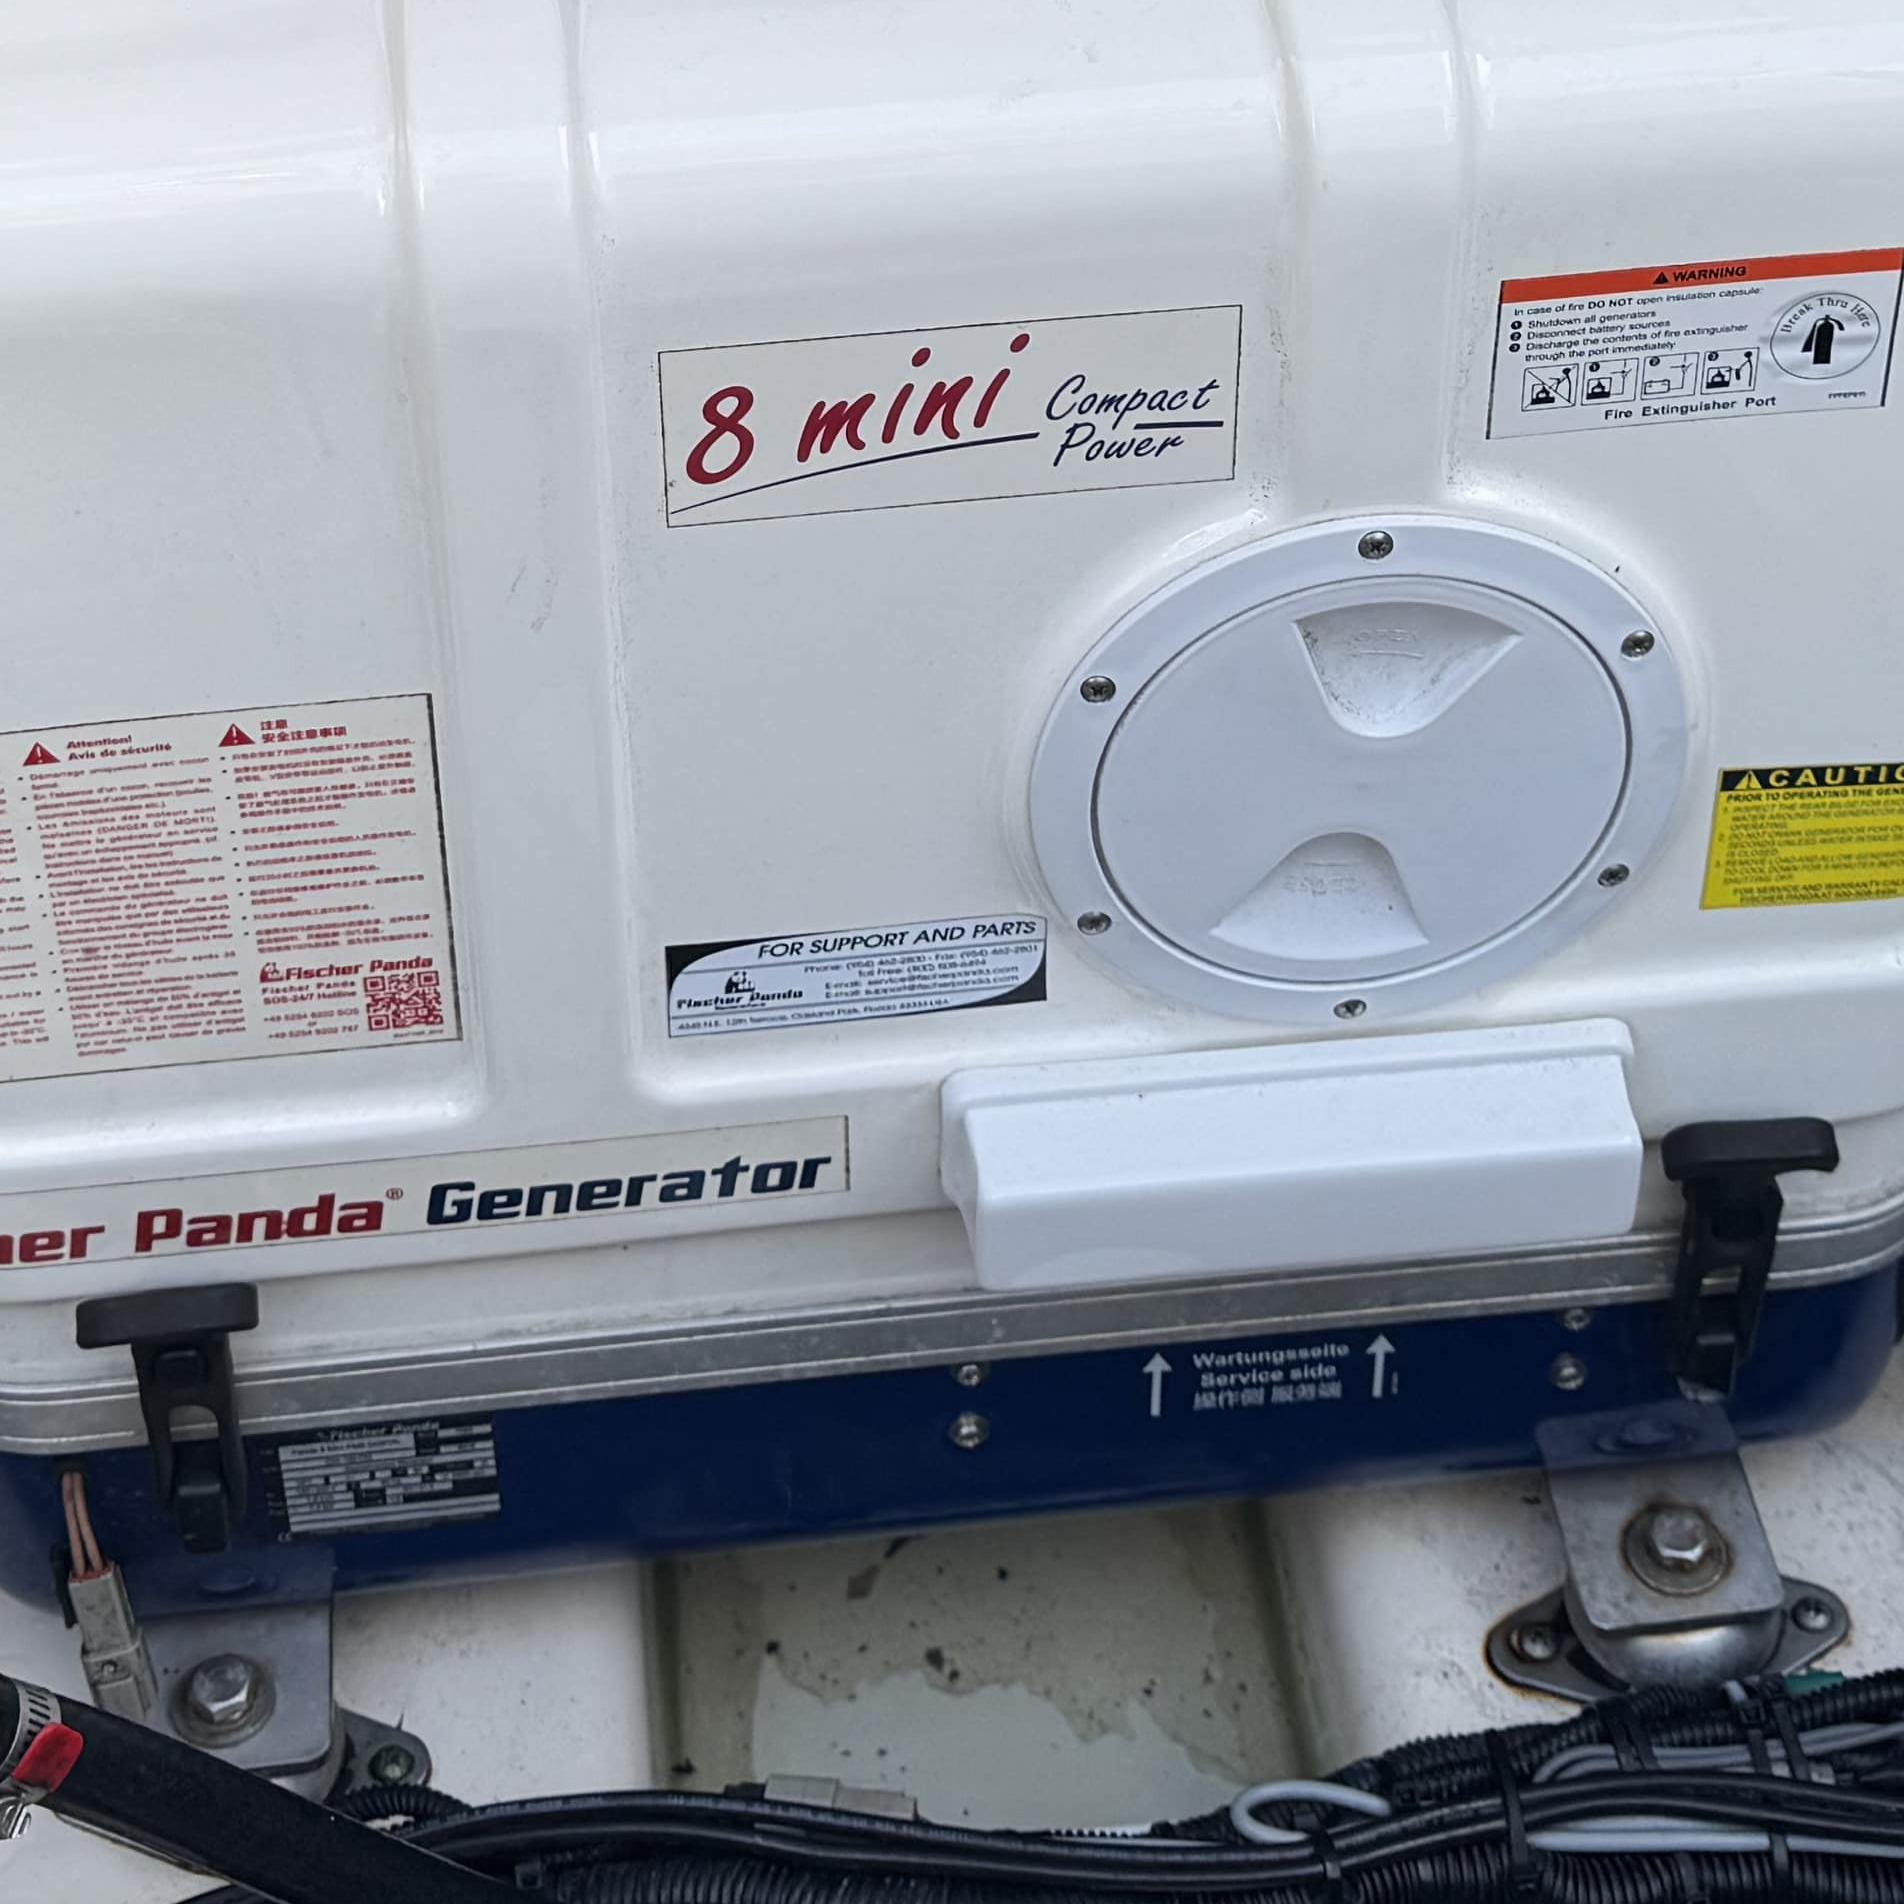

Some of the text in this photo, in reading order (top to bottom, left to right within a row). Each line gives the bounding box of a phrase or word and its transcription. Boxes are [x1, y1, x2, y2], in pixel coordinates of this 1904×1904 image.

[1672, 265, 1747, 282] WARNING
[1514, 306, 1524, 316] In
[1526, 303, 1553, 315] case
[1555, 302, 1565, 312] of
[1567, 301, 1584, 311] fire
[1587, 299, 1606, 310] DO
[1608, 297, 1632, 308] NOT
[1635, 294, 1663, 306] open
[1665, 290, 1717, 303] insulation
[1779, 295, 1873, 335] Break Thru Here
[1527, 326, 1586, 340] Disconnect
[1589, 323, 1627, 335] battery
[1629, 319, 1670, 331] sources
[1528, 315, 1582, 328] Shutdown
[1584, 314, 1597, 324] all
[1599, 309, 1656, 323] generators
[1526, 337, 1579, 351] Discharge
[1582, 335, 1599, 346] the
[1602, 331, 1648, 344] contents
[1650, 330, 1661, 341] of
[1663, 329, 1680, 339] fire
[1682, 323, 1748, 338] extinguisher
[1524, 340, 1676, 362] through the port immediately
[686, 332, 1220, 485] 8 mini Compact
[1604, 395, 1776, 420] Fire Extinguisher Port
[1053, 422, 1185, 467] Power
[65, 734, 132, 750] Attention!
[67, 743, 172, 760] Avis de sécurité
[1726, 792, 1763, 803] PRIOR
[1764, 791, 1781, 800] TO
[1782, 787, 1849, 801] OPERATING
[1851, 786, 1871, 796] THE
[757, 919, 1037, 959] FOR SUPPORT AND PARTS
[286, 952, 435, 983] Fischer Panda
[261, 976, 355, 998] Fischer Panda
[426, 1153, 833, 1228] Generator
[1192, 1342, 1350, 1370] Wartungsseite
[1200, 1362, 1337, 1388] Service side
